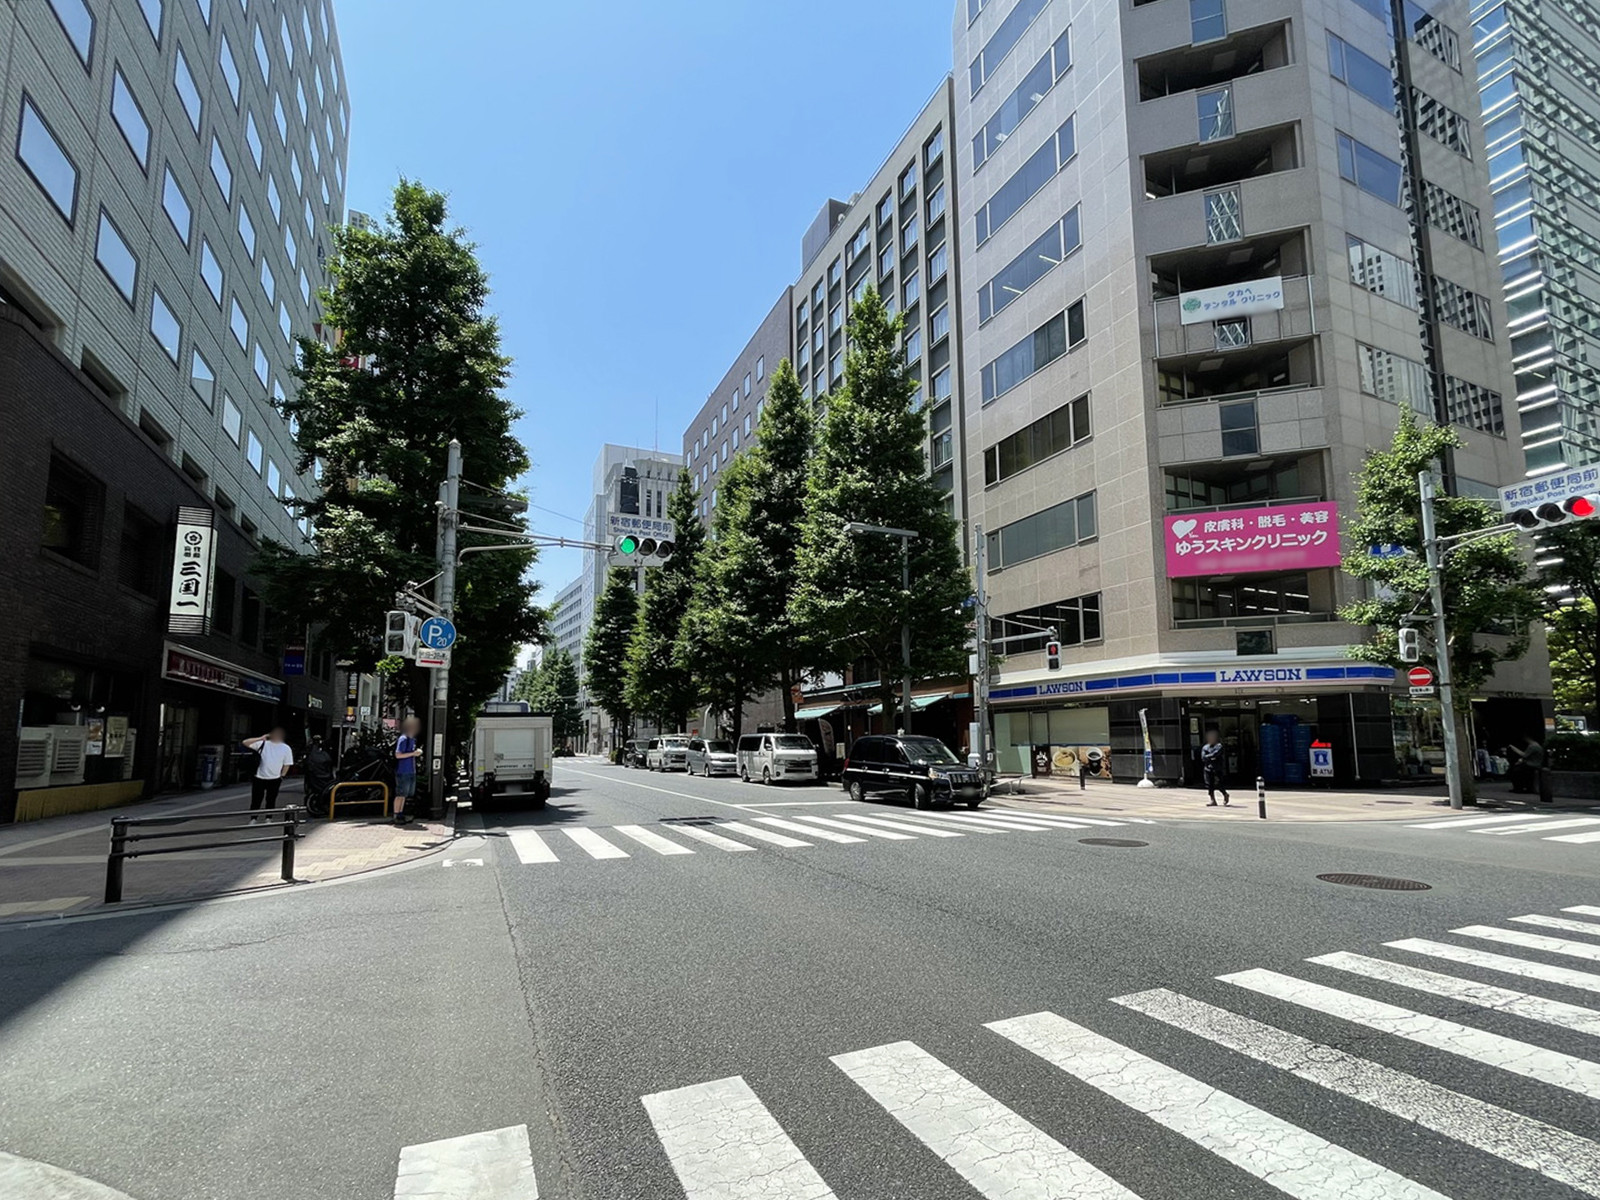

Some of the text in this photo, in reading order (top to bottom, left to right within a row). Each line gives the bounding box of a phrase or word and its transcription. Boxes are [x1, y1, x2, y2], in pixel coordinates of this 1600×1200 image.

[1241, 291, 1280, 304] クリニック
[1504, 468, 1599, 501] 新宿郵便局前
[1510, 482, 1595, 508] Shinjuku Post Office
[610, 515, 672, 533] 新宿郵便局前
[613, 526, 637, 535] Shinjuku
[1175, 529, 1328, 556] ゆうスキンクリニック
[176, 561, 202, 607] 三国一
[428, 625, 443, 645] P
[437, 637, 448, 647] 20
[1219, 668, 1302, 682] LAWSON
[1039, 681, 1083, 694] LAWSON
